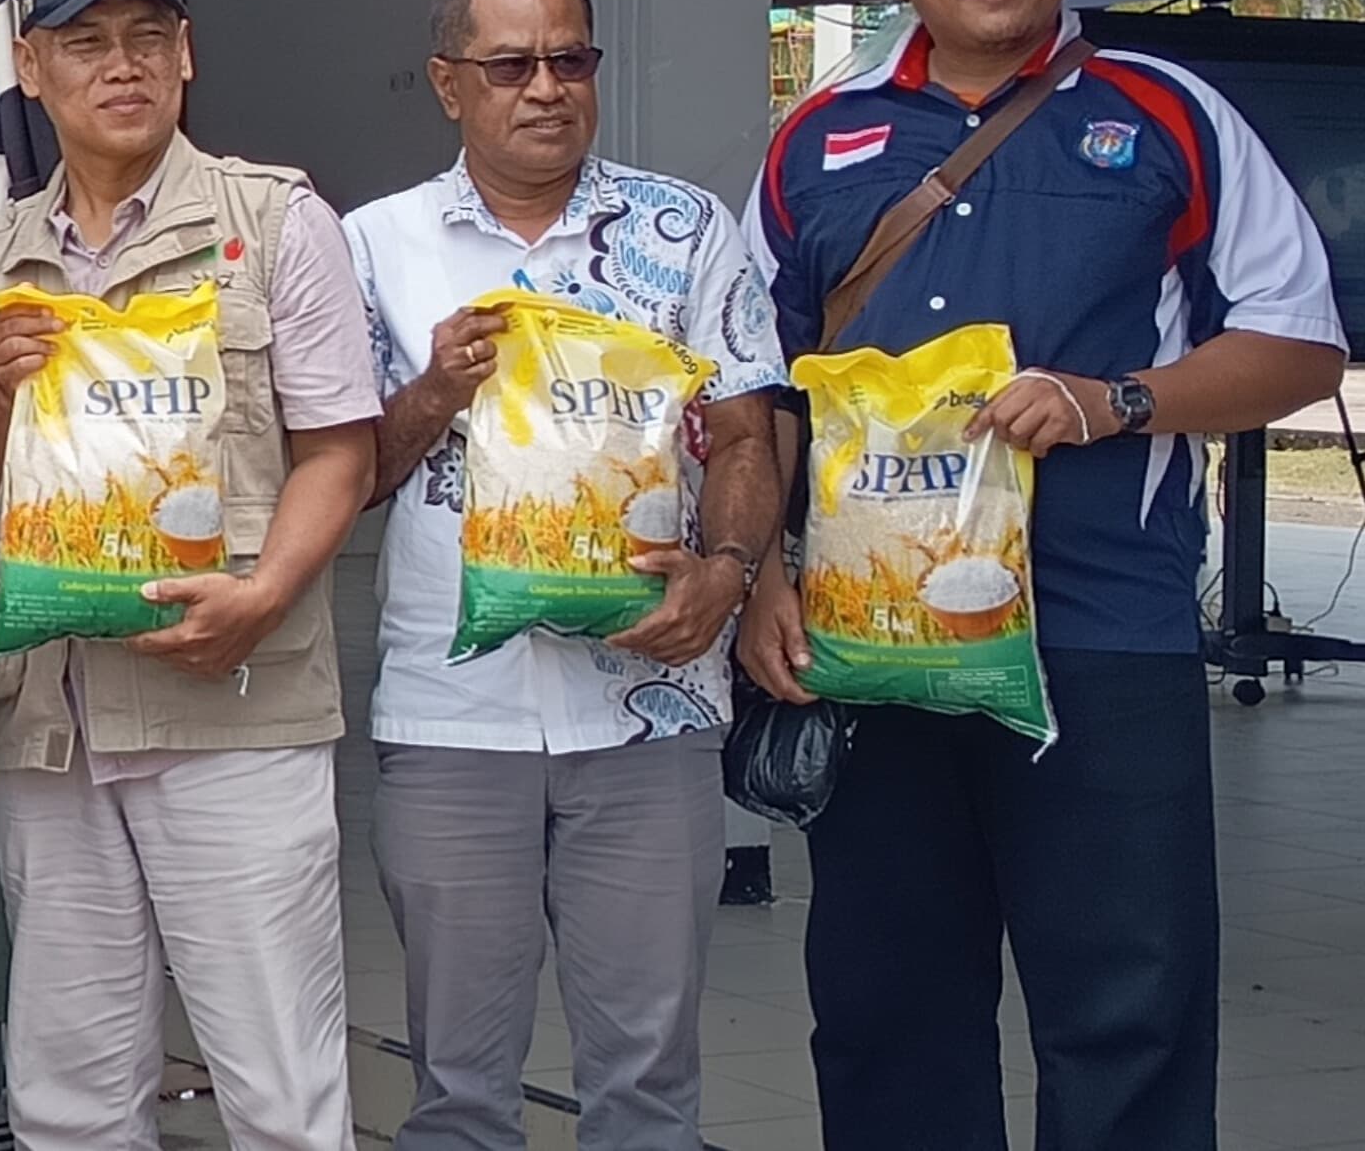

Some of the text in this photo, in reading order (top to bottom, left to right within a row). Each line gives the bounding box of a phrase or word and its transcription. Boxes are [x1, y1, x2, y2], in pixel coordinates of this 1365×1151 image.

[84, 374, 212, 416] SPHP
[549, 378, 667, 425] SPHP
[103, 533, 118, 559] 5
[573, 536, 589, 560] 5
[872, 609, 915, 636] 5 kg
